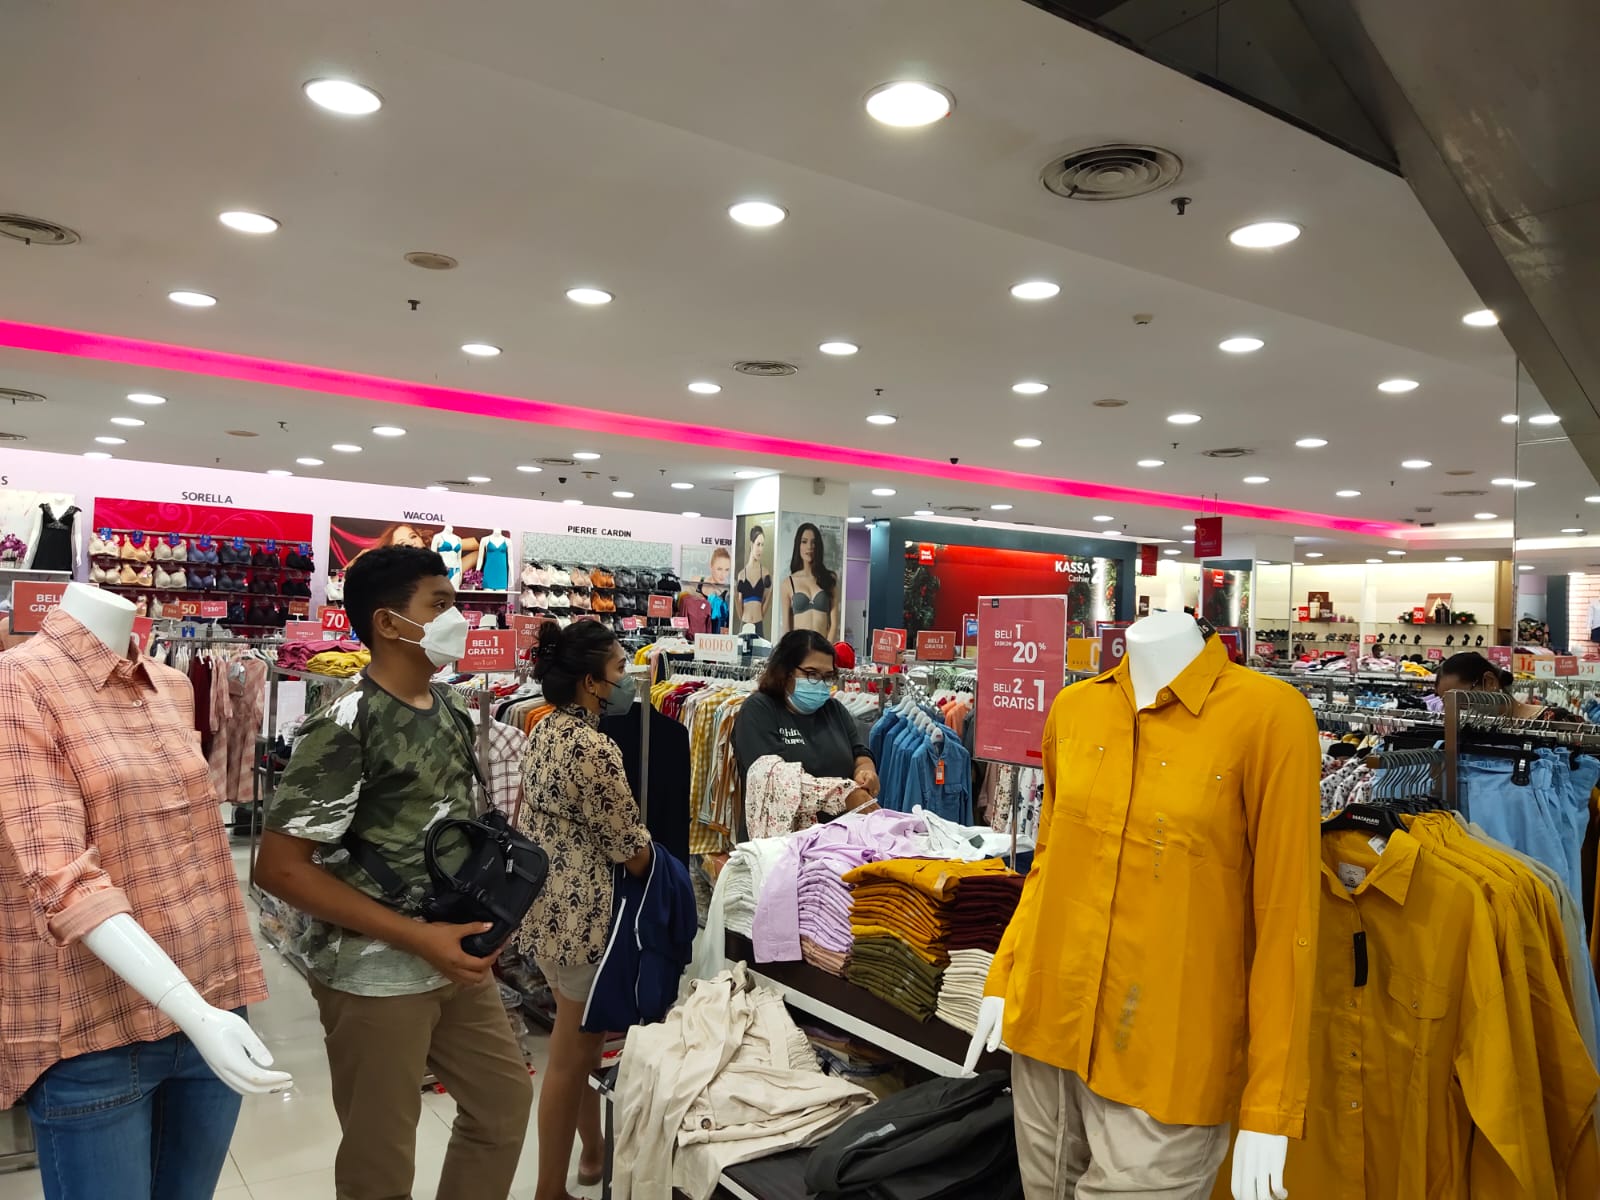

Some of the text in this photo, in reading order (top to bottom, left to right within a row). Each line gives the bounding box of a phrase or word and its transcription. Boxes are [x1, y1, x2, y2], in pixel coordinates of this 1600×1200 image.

[181, 491, 233, 504] SORELLA
[403, 511, 445, 522] WACOAL
[567, 525, 632, 538] PIERRE CARDIN
[701, 536, 712, 545] LEE
[1055, 560, 1090, 574] KASSA
[1068, 574, 1090, 582] Cashier
[181, 604, 197, 615] 50
[326, 612, 345, 628] 70
[994, 623, 1021, 640] BELI 1
[472, 636, 499, 647] BELI 1
[699, 639, 734, 651] RODEO
[993, 678, 1022, 694] BELI 2
[992, 679, 1045, 712] GRATIS 1
